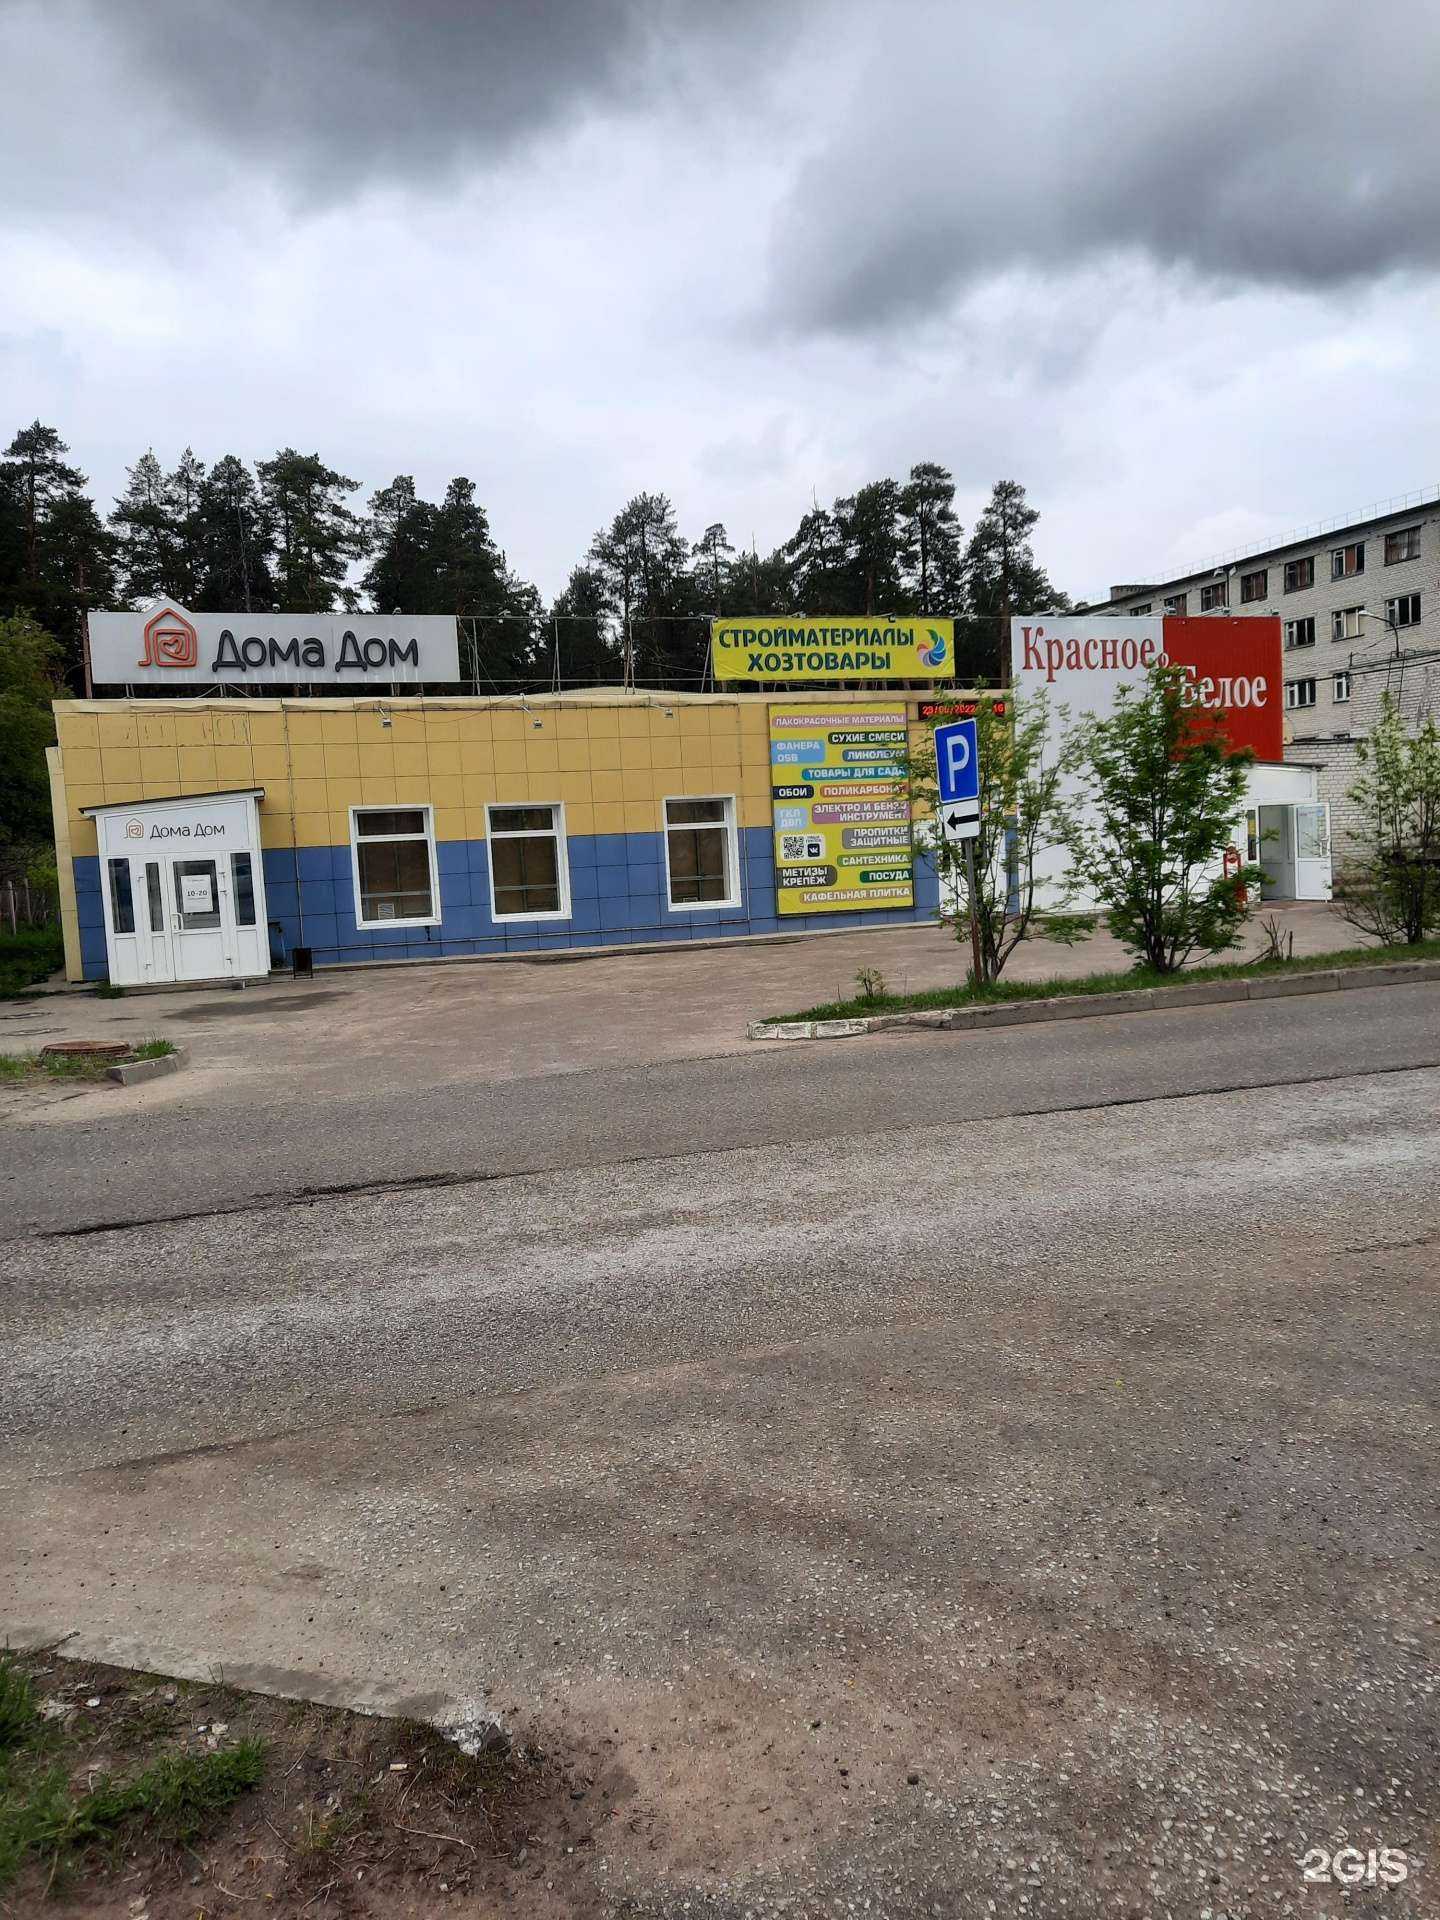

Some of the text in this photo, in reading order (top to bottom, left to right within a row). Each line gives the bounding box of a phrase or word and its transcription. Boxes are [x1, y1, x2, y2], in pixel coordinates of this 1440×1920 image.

[718, 627, 914, 648] СТРОЙМАТЕРИАЛЫ
[212, 629, 419, 673] Дома Дом
[1021, 626, 1156, 682] Красное
[748, 651, 891, 672] ХОЗТОВАРЫ
[1179, 665, 1268, 708] Белое
[776, 715, 904, 726] ЛАКОКРАСОЧНЫЕ МАТЕРИАЛЫ
[832, 732, 905, 743] СУХИЕ СМЕСИ
[776, 742, 820, 751] ФАНЕРА
[808, 768, 851, 778] ТОВАРЫ
[853, 767, 876, 777] ДЛЯ
[778, 788, 808, 797] ОБОИ
[814, 803, 861, 814] ЭЛЕКТРО
[863, 802, 872, 811] И
[149, 823, 226, 840] Дома Дом
[850, 835, 909, 847] ЗАЩИТНЫЕ
[842, 854, 910, 866] САНТЕХНИКА
[782, 867, 828, 877] МЕТИЗЫ
[869, 870, 910, 881] ПОСУДА
[187, 889, 208, 897] 10-20
[804, 887, 911, 902] КАФЕЛЬНАЯ ПЛИТКА
